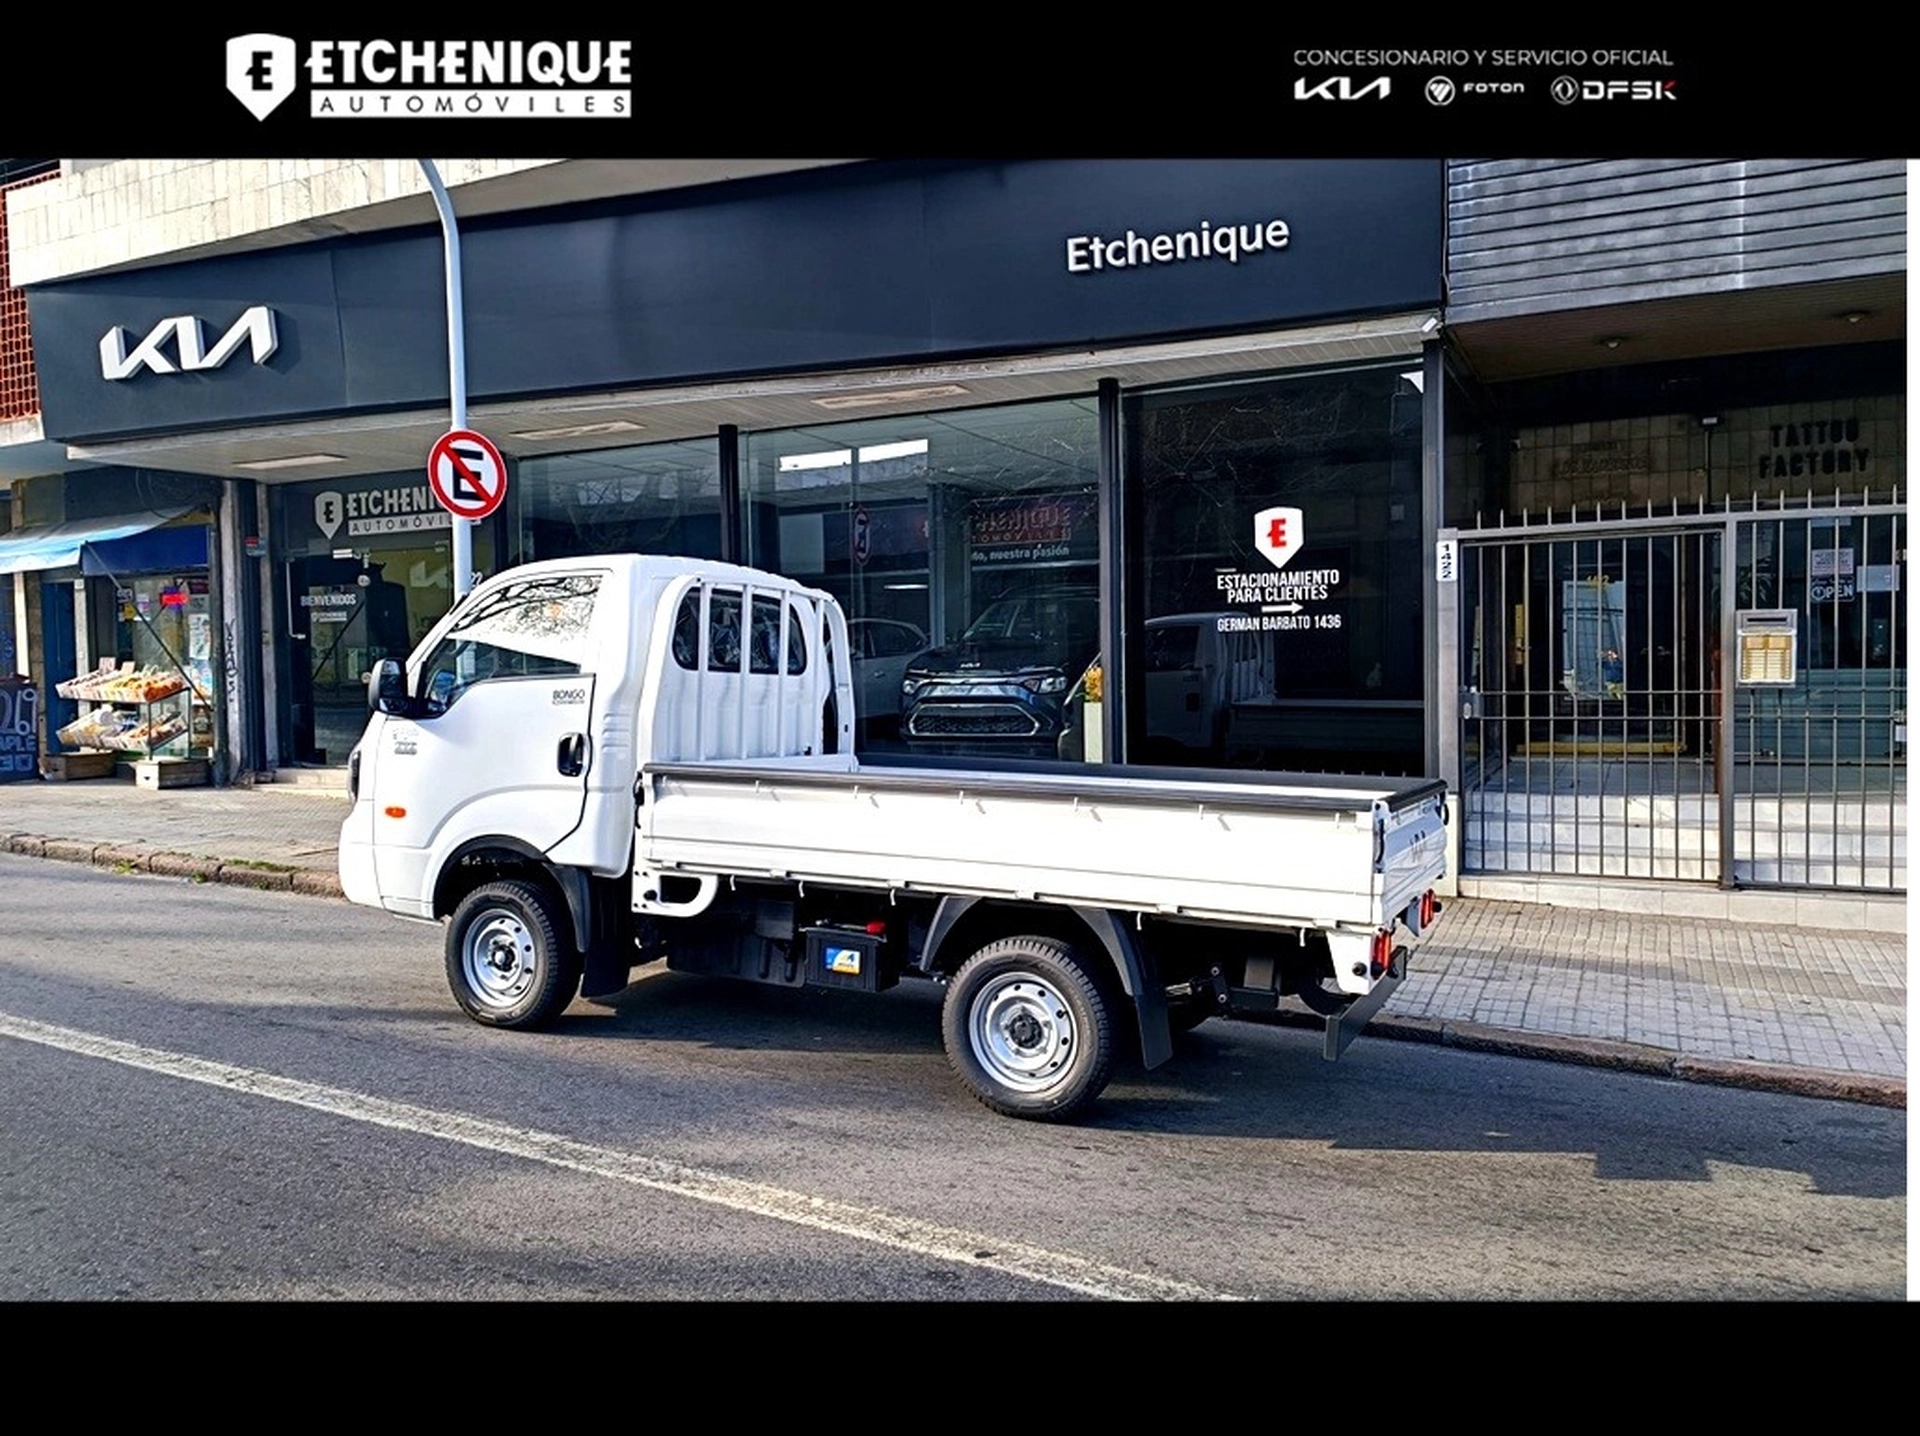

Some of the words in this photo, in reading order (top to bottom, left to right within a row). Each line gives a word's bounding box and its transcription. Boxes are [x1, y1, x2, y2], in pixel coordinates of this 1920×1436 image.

[1066, 218, 1290, 272] Etchenique
[99, 305, 278, 381] KIA
[1759, 448, 1869, 479] FACTORY
[347, 486, 444, 517] ETCHENI
[351, 514, 451, 533] AUTOMÓVI
[990, 548, 1031, 560] nuestra
[1217, 569, 1340, 590] ESTACIONAMIENTO
[1227, 588, 1262, 603] PARA
[1264, 584, 1329, 602] CLIENTES
[1217, 617, 1260, 632] GERMAN
[1262, 615, 1311, 630] BARBATO
[1314, 614, 1342, 629] 1436
[553, 689, 585, 700] BONGO
